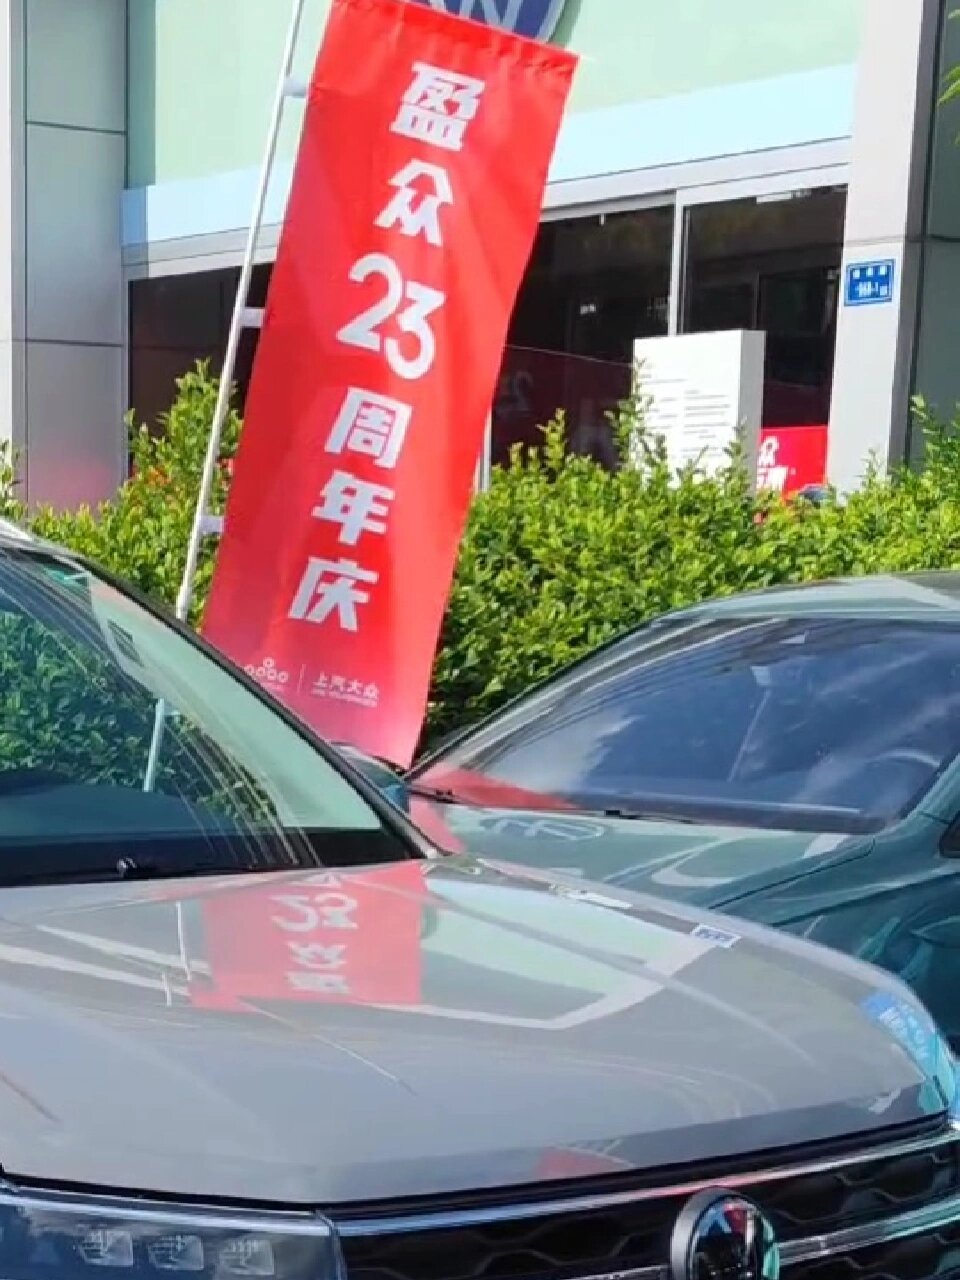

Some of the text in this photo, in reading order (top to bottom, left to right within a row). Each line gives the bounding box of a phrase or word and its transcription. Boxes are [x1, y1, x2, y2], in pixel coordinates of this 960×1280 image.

[288, 62, 485, 632] 盈众23周年庆
